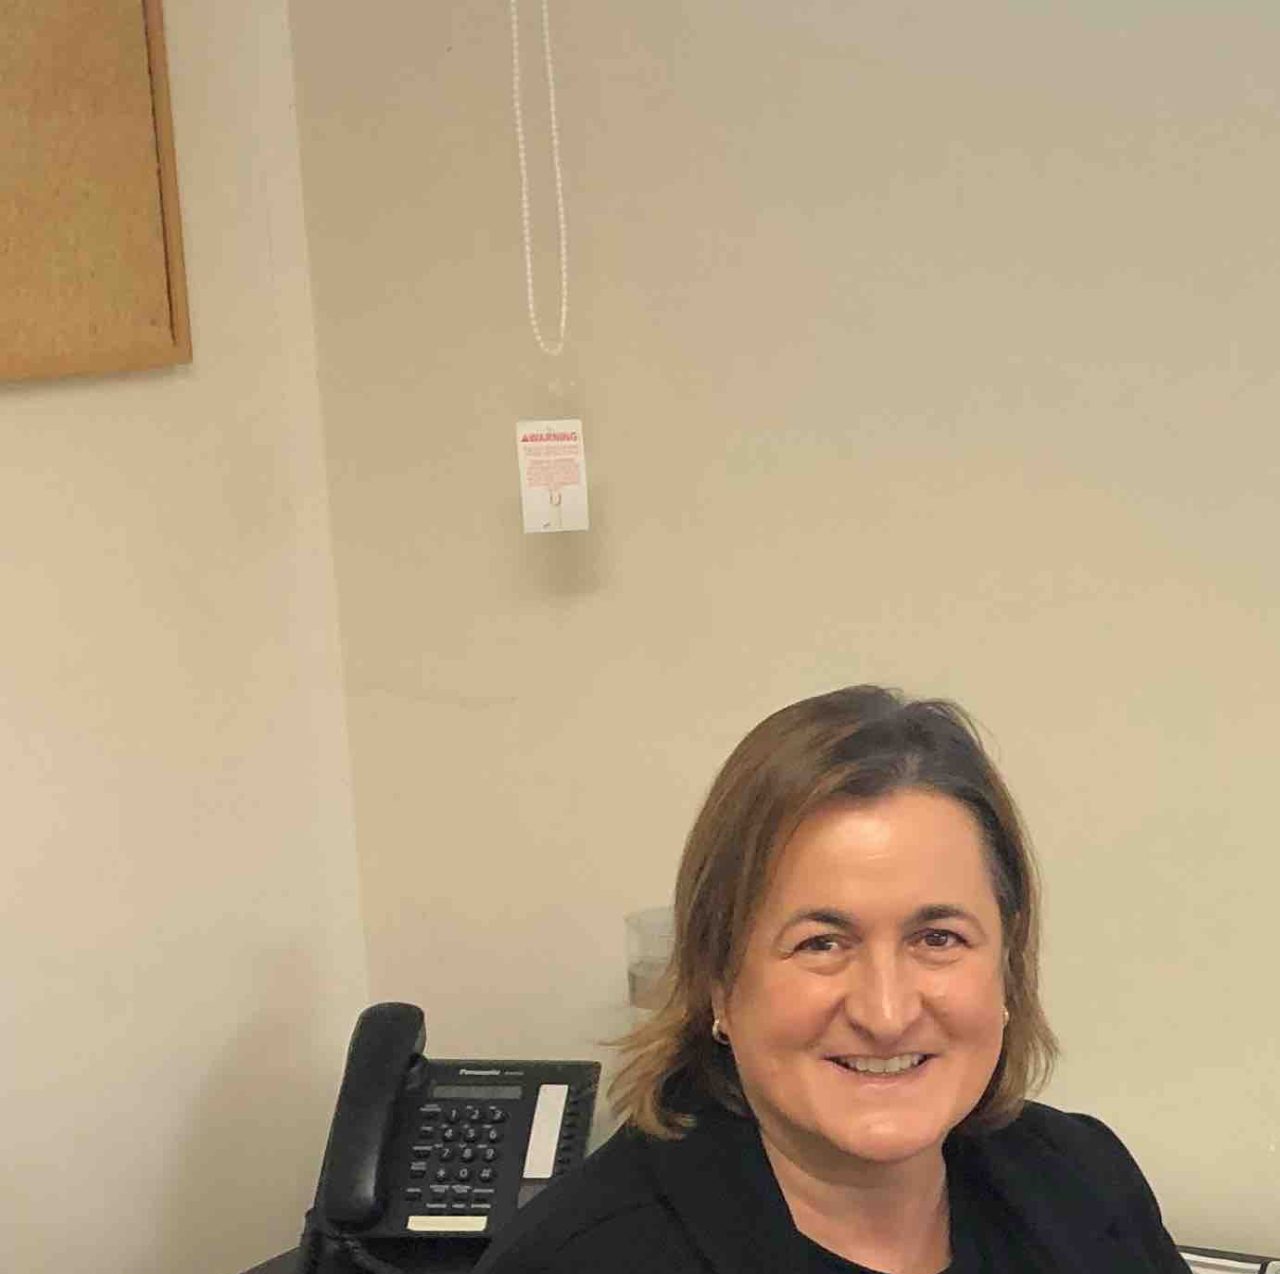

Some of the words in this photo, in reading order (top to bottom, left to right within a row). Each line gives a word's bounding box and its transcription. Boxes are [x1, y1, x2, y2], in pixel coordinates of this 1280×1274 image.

[471, 1109, 480, 1120] 2
[444, 1128, 453, 1138] 4
[489, 1129, 497, 1140] 6
[442, 1148, 450, 1158] 7
[463, 1148, 472, 1159] 8
[486, 1148, 495, 1159] 9
[459, 1168, 468, 1178] 0
